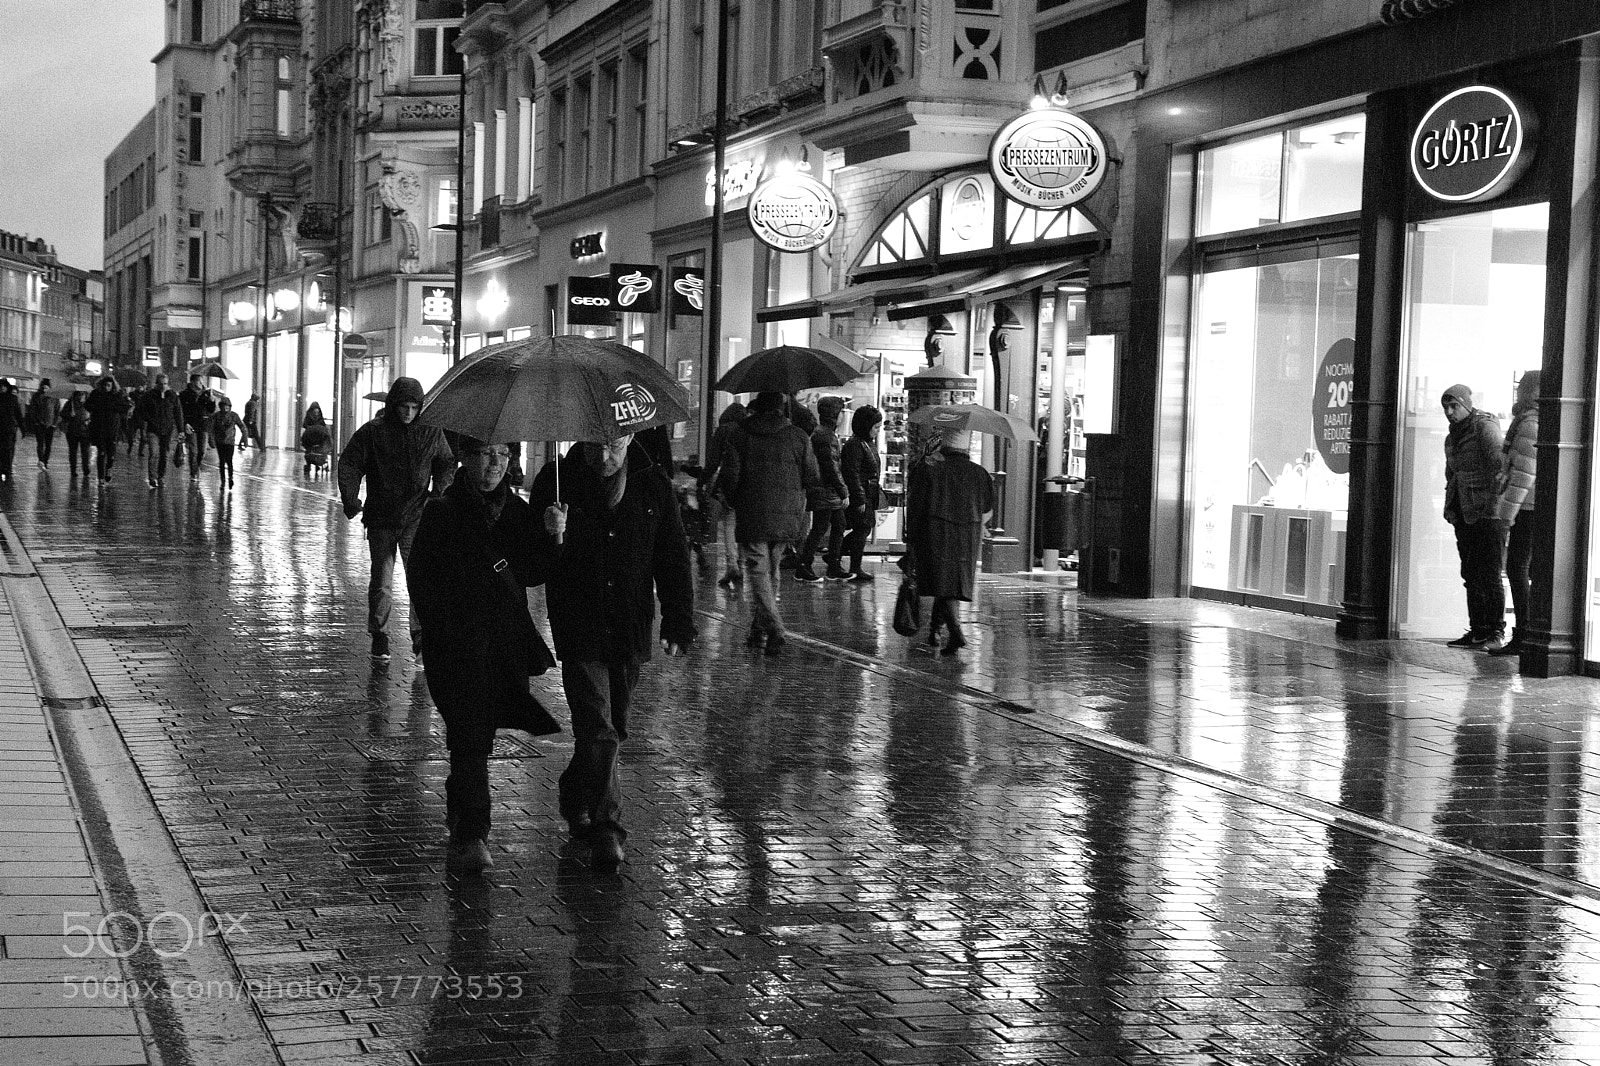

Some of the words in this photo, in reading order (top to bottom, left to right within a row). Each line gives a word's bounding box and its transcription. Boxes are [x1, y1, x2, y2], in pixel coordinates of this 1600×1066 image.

[1421, 114, 1512, 170] GÖRTZ
[1009, 149, 1089, 166] PRESSEZENTRUM
[1011, 177, 1033, 196] MUSIK
[1038, 190, 1065, 200] BÜCHER
[1068, 177, 1088, 195] VIDEO
[761, 204, 826, 218] PRESSEZENTRUM
[610, 400, 640, 421] ZFH
[1323, 412, 1348, 426] RABATT
